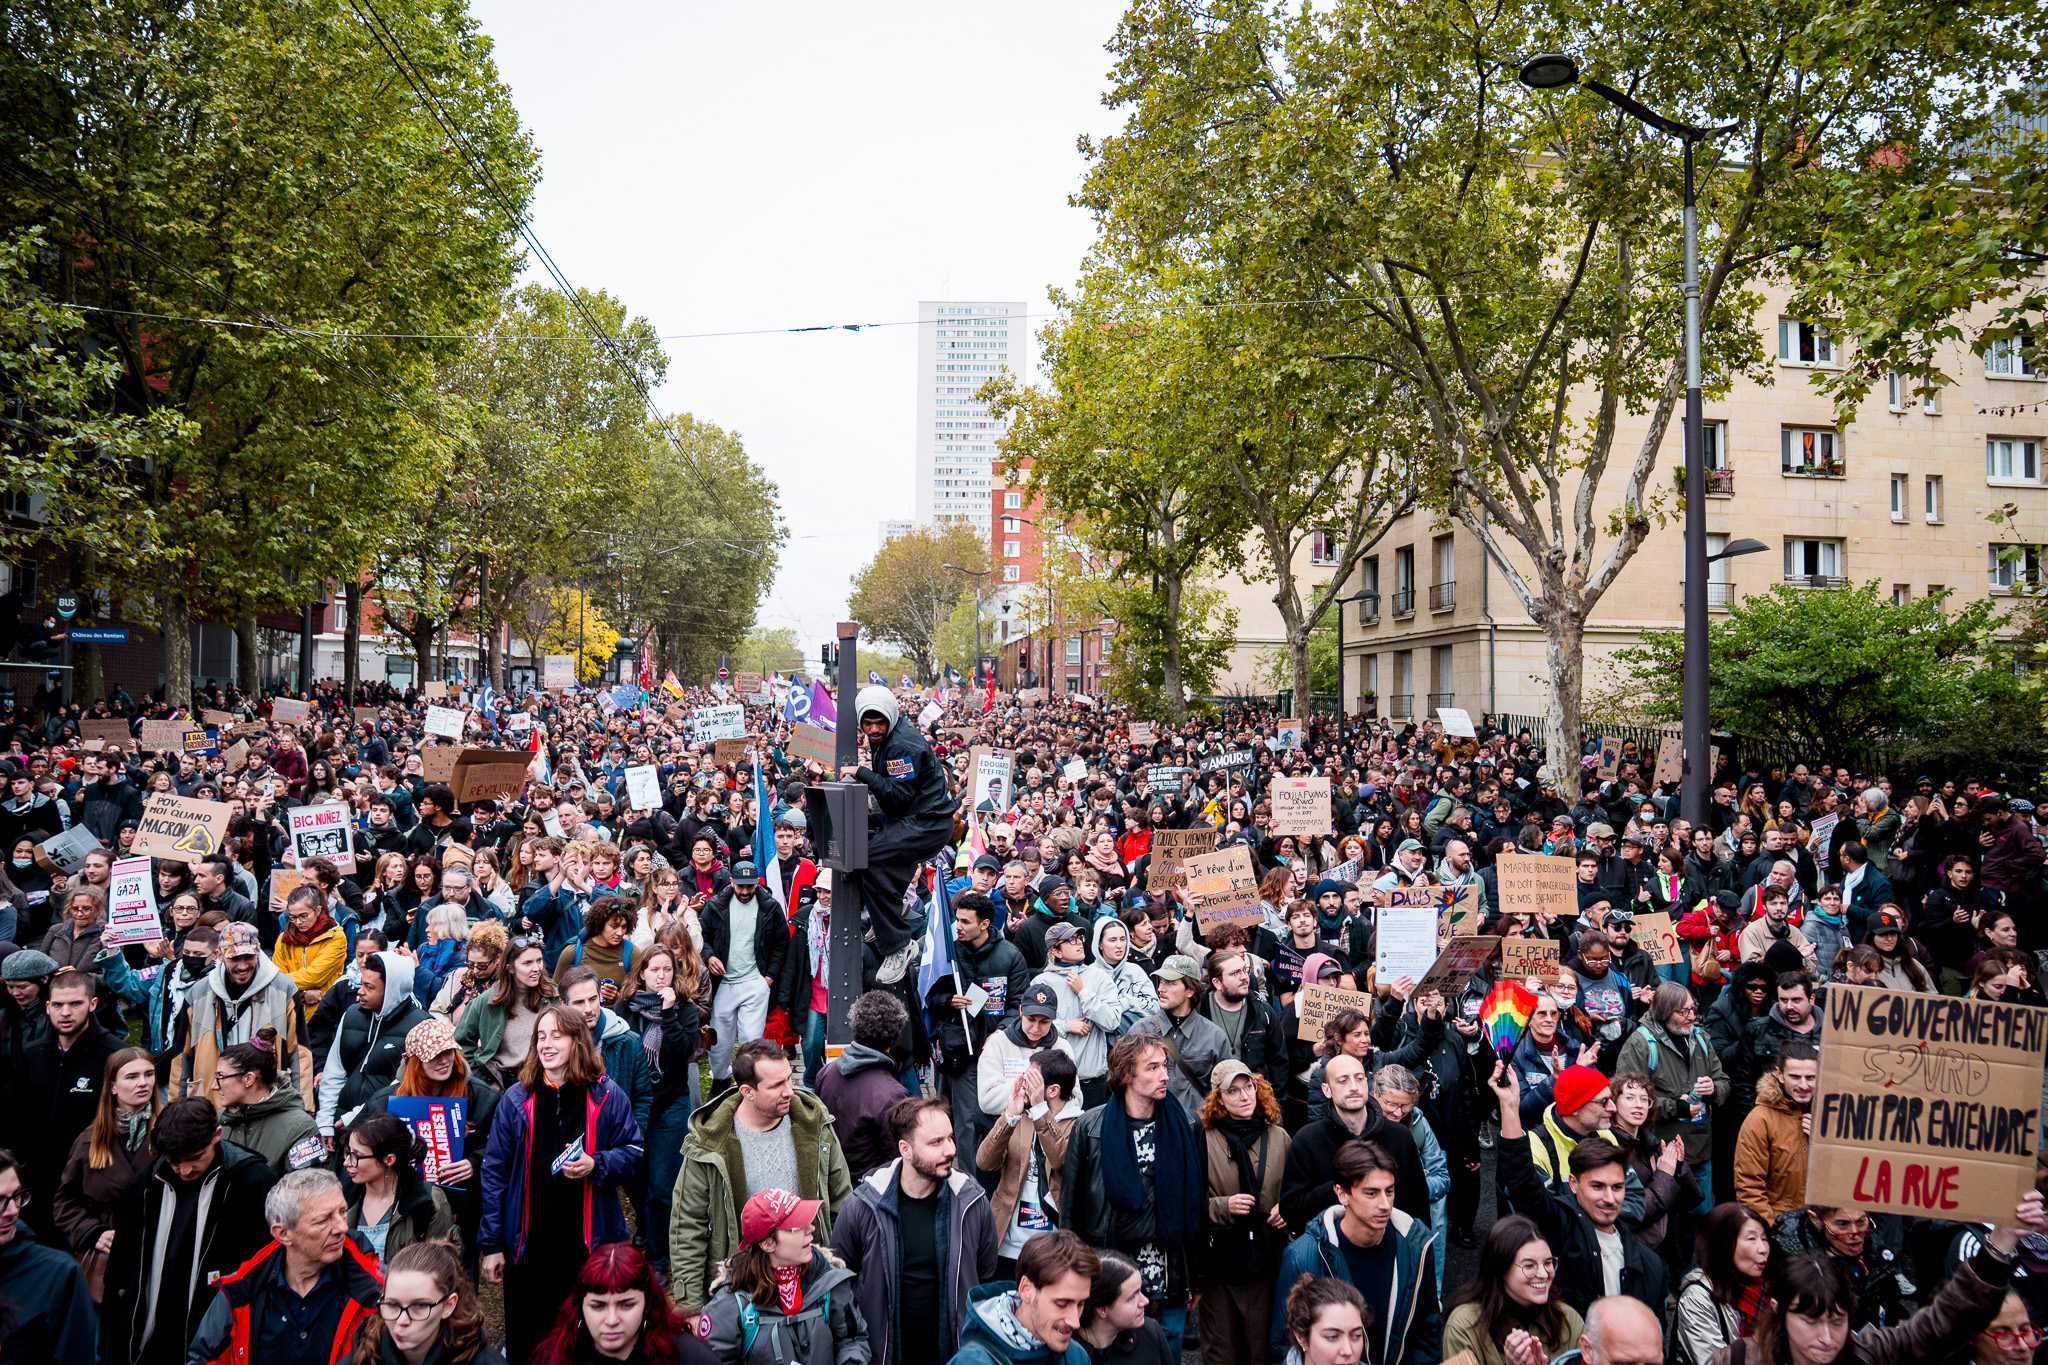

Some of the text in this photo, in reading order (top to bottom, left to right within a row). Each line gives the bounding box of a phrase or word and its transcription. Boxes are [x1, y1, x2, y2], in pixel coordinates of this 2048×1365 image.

[59, 598, 76, 606] BUS
[793, 742, 807, 754] TES
[1605, 741, 1620, 749] LUTTE
[1208, 752, 1244, 770] AMOUR
[149, 806, 212, 823] MOI QUAND
[294, 810, 342, 828] BIG NUÑEZ
[140, 818, 190, 838] MACRON
[1162, 849, 1173, 858] ME
[1190, 864, 1202, 879] Je
[1206, 864, 1225, 875] rêve
[1228, 859, 1245, 872] d'un
[1534, 863, 1551, 873] RENDS
[1242, 878, 1254, 886] me
[1505, 880, 1515, 888] ON
[117, 884, 140, 896] GAZA
[1235, 891, 1254, 901] dans
[1391, 890, 1430, 907] DANS
[1506, 894, 1515, 904] DE
[1517, 894, 1531, 904] NOS
[1536, 894, 1562, 904] ENFANTS
[1200, 917, 1209, 925] un
[1507, 947, 1522, 957] LE
[1519, 959, 1548, 967] PARLE
[1310, 989, 1321, 998] TU
[1305, 1000, 1321, 1009] NOUS
[1304, 1008, 1324, 1018] D'ALLER
[1304, 1018, 1316, 1026] SUR
[1832, 988, 2048, 1052] UN GOUVERNEMENT
[1820, 1093, 2038, 1157] FINIT PAR ENTENDRE
[419, 1122, 434, 1147] DES
[1854, 1156, 1960, 1210] LA RUE
